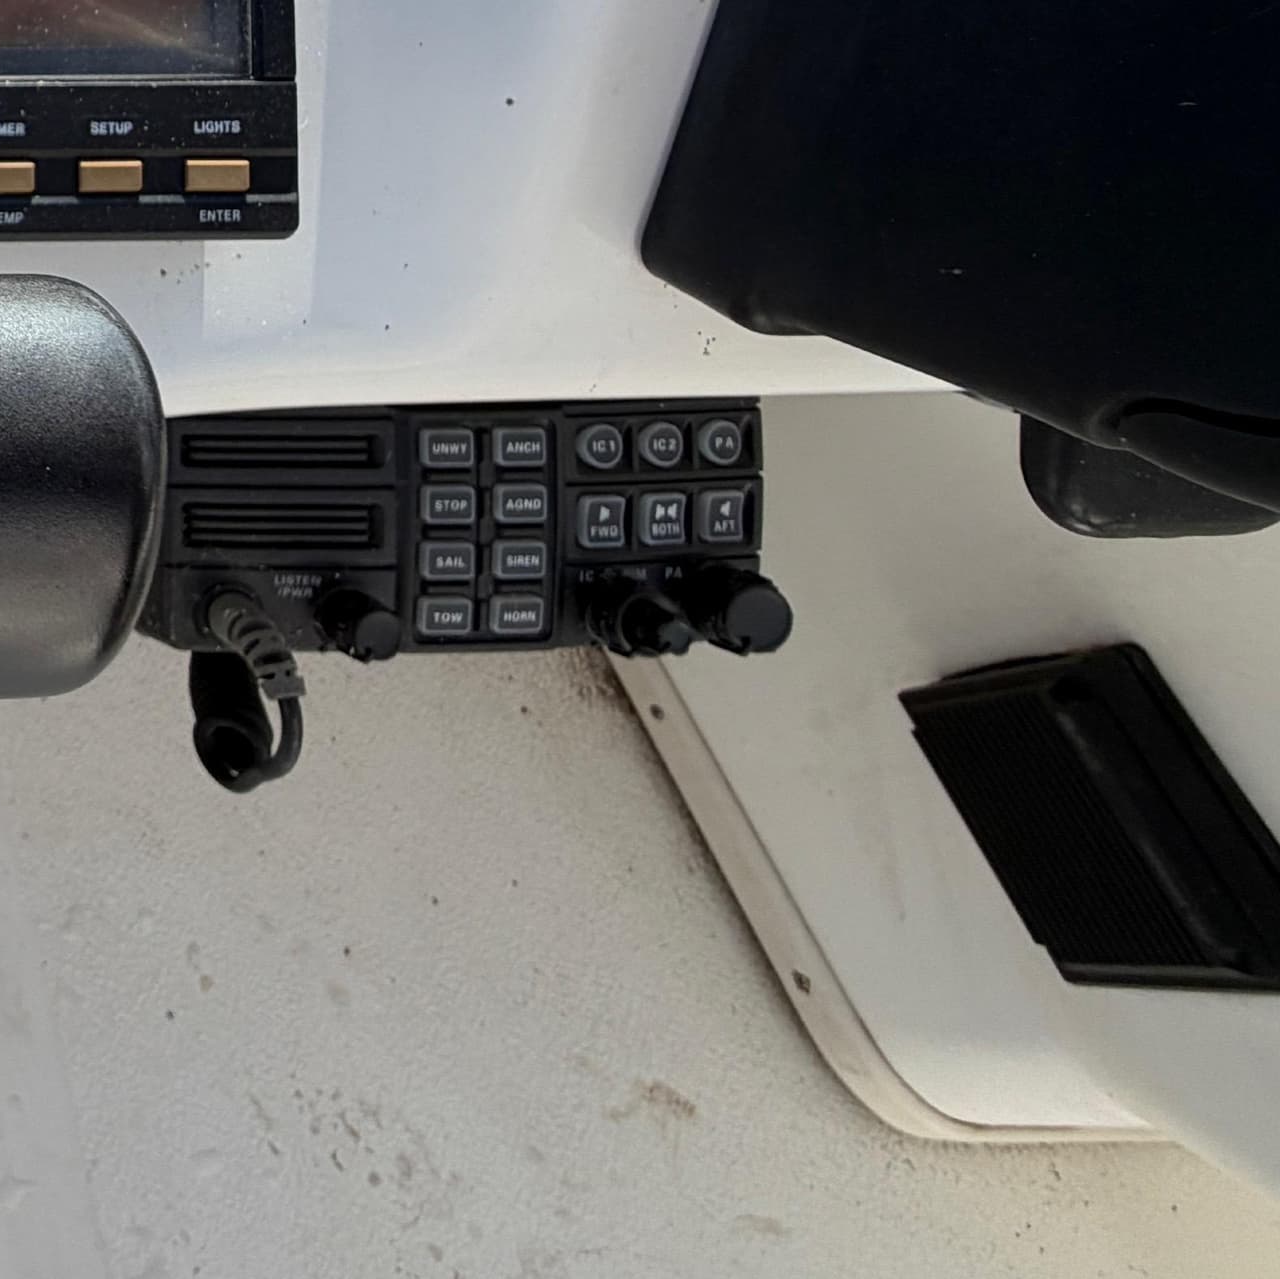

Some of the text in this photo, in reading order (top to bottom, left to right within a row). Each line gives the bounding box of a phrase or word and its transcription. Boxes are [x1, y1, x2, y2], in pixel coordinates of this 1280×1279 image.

[90, 120, 134, 136] SETUP
[193, 119, 241, 134] LIGHTS
[199, 209, 241, 222] ENTER
[506, 441, 541, 454] ANCH
[653, 438, 666, 451] IC
[435, 500, 468, 512] STOP
[506, 498, 542, 511] AGND
[590, 525, 618, 537] FWD
[652, 523, 679, 536] BOTH
[714, 521, 735, 533] AFT
[436, 556, 465, 569] SAIL
[506, 554, 540, 568] SIREN
[433, 611, 463, 624] TOW
[504, 611, 536, 622] HORN
